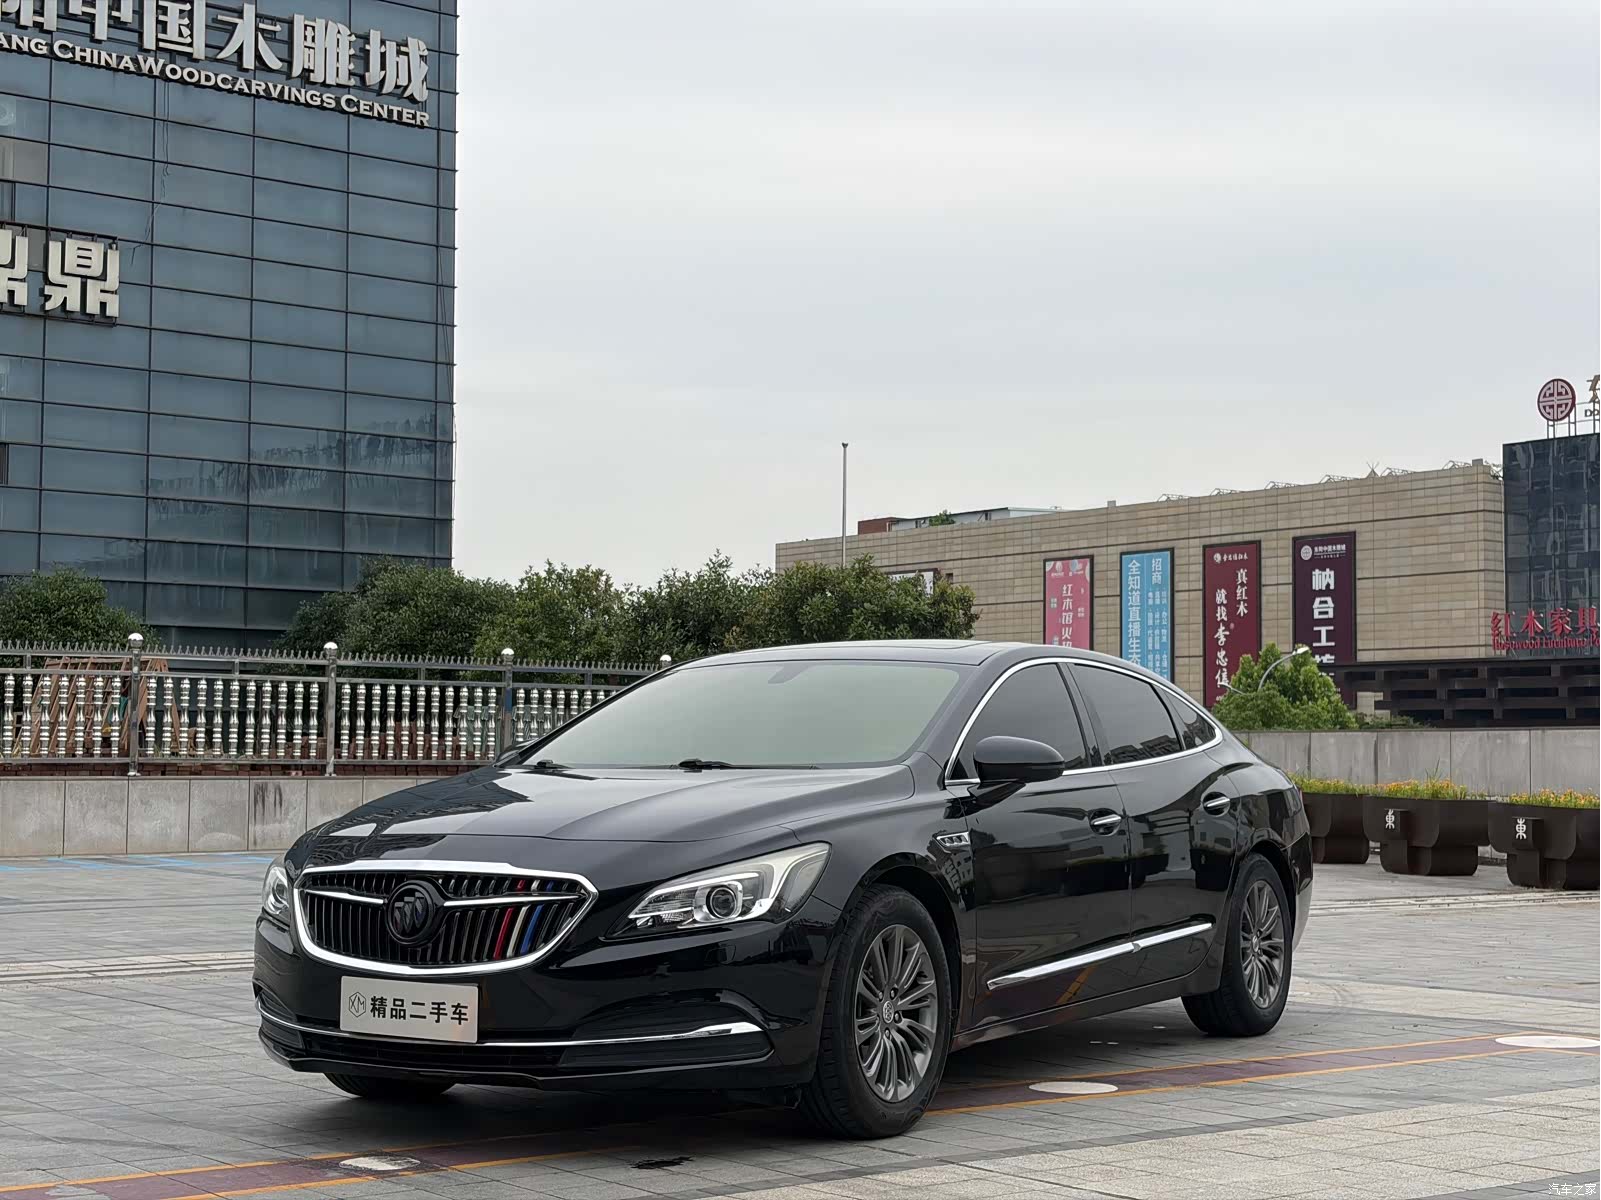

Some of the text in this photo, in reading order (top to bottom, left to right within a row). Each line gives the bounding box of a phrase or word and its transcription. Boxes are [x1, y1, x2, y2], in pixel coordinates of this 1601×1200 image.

[340, 95, 430, 127] CENTER
[1151, 557, 1162, 585] 招商
[1235, 568, 1248, 617] 真红木
[370, 995, 469, 1026] 精品二手车
